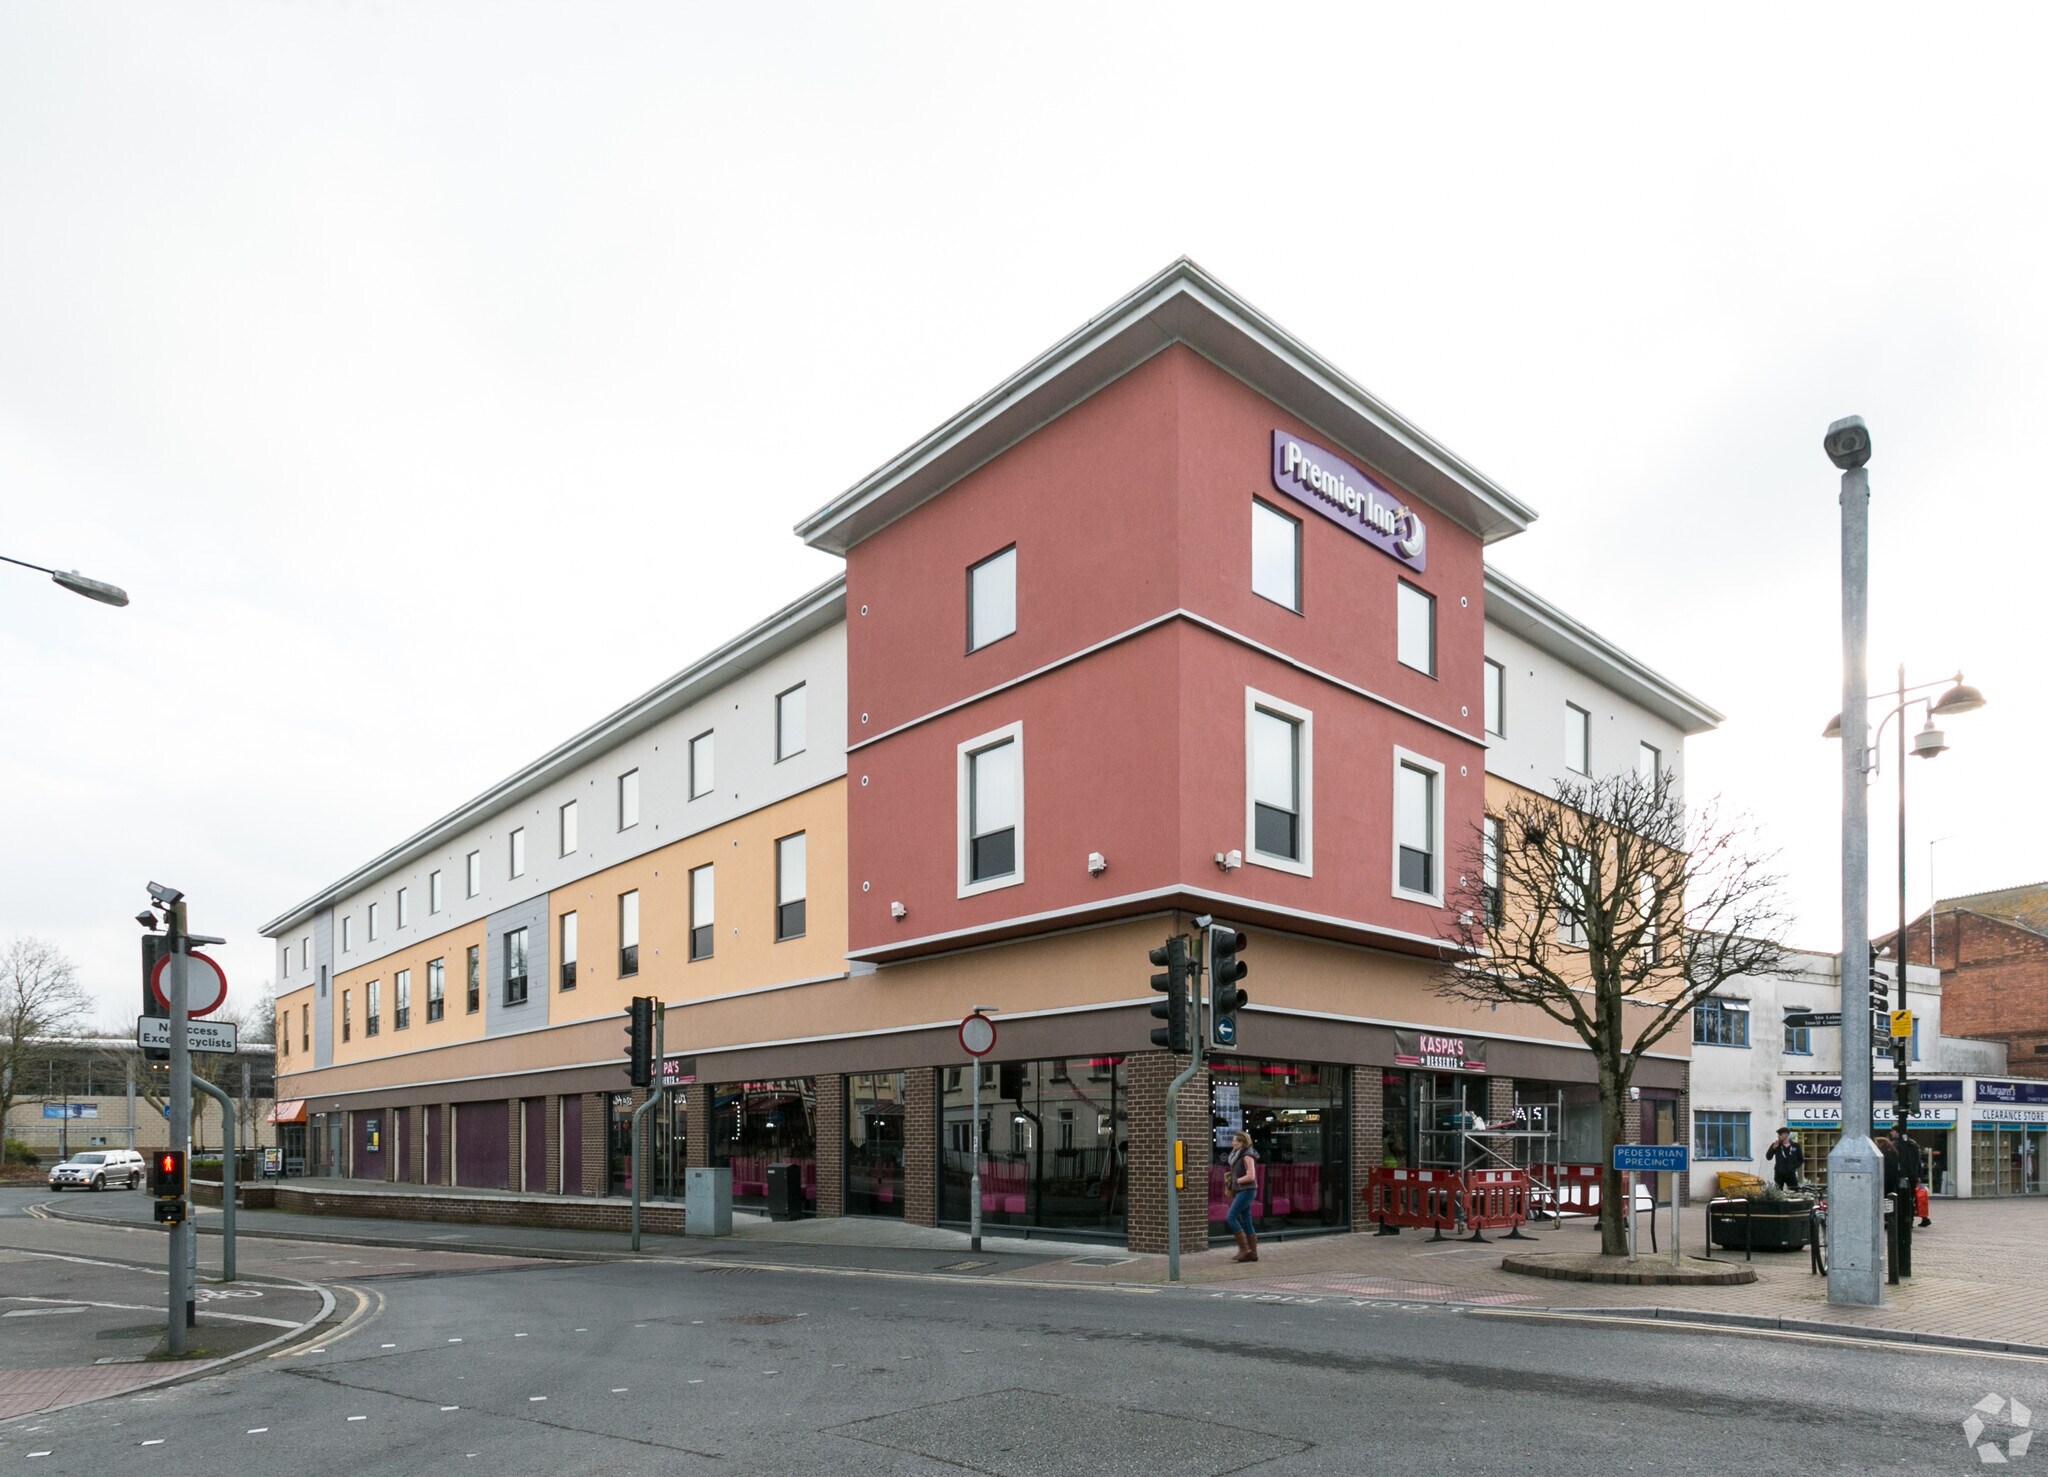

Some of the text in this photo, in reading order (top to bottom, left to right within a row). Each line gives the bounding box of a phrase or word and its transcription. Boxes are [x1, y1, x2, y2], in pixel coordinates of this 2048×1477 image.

[1283, 441, 1395, 535] Premier Inn
[186, 1027, 218, 1036] ccess
[143, 1033, 232, 1048] Exce cyclists
[1420, 1036, 1464, 1055] KASPA'S
[1426, 1056, 1458, 1068] DESSERTS
[1804, 1109, 1890, 1119] CLEACE
[1982, 1109, 2045, 1121] CLEARANCE STORE
[1617, 1148, 1684, 1158] PEDESTRIAN
[1625, 1157, 1676, 1167] PRECINCT
